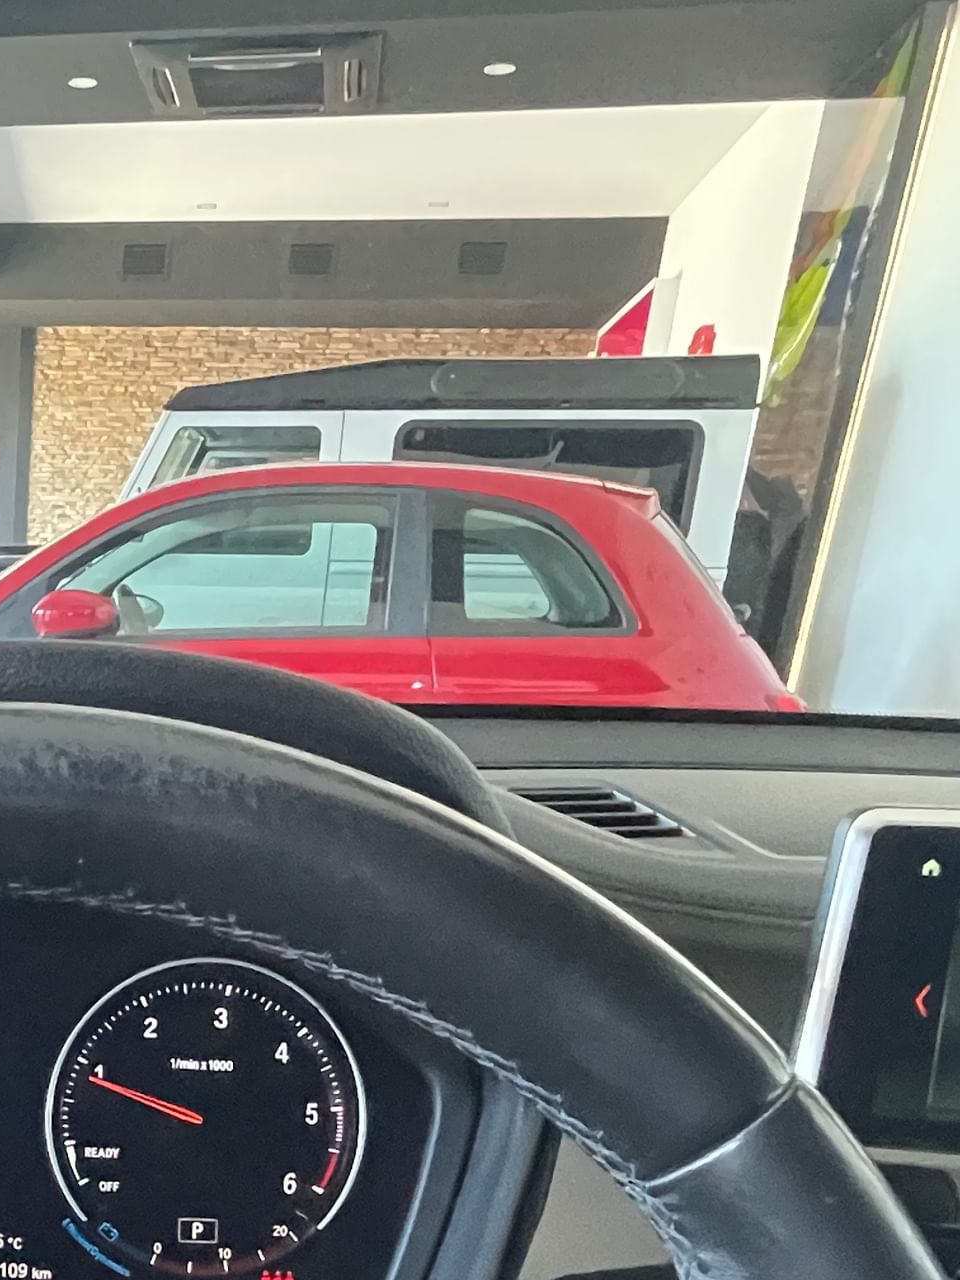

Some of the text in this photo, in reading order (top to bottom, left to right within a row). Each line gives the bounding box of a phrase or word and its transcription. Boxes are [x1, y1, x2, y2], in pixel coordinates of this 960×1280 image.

[213, 1007, 229, 1029] 3
[143, 1016, 158, 1039] 2
[274, 1041, 290, 1065] 4
[93, 1063, 105, 1079] 1
[169, 1057, 200, 1071] 1/min
[208, 1059, 234, 1072] 1000
[304, 1102, 319, 1126] 5
[84, 1146, 121, 1159] READY
[98, 1180, 120, 1193] OFF
[282, 1172, 298, 1195] 6
[191, 1222, 204, 1239] P
[272, 1224, 289, 1238] 20
[152, 1241, 163, 1254] 0
[217, 1247, 232, 1260] 10
[0, 1261, 53, 1280] 109 km
